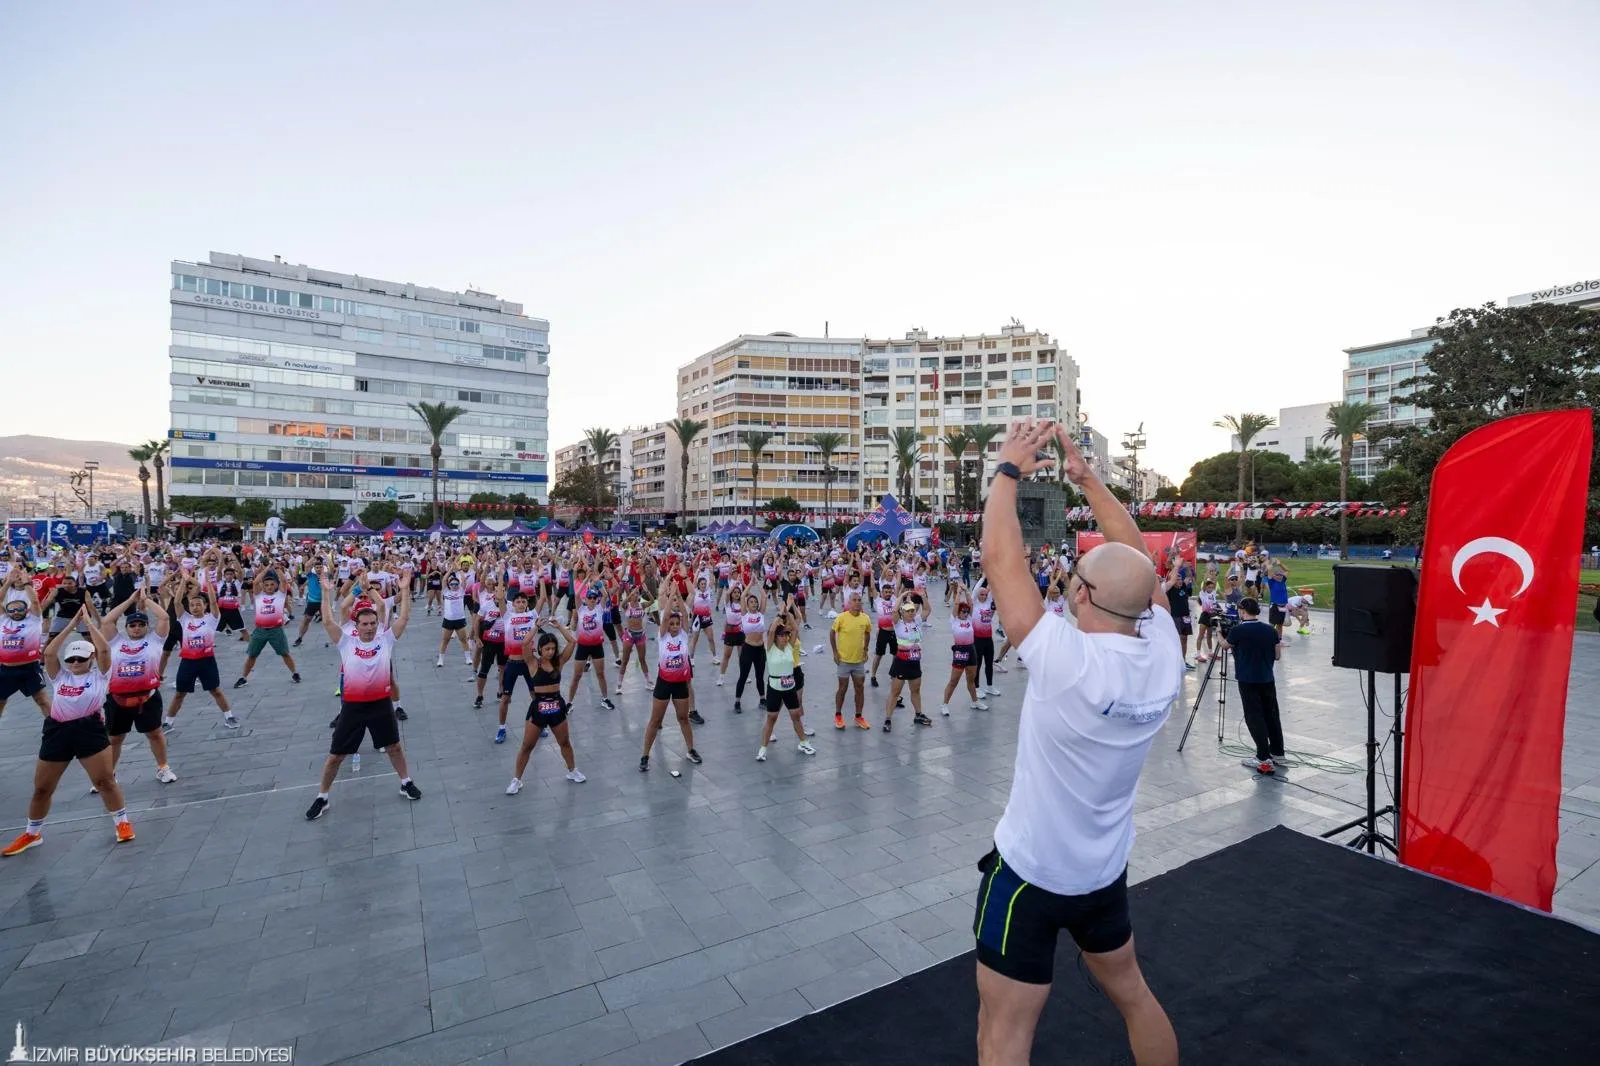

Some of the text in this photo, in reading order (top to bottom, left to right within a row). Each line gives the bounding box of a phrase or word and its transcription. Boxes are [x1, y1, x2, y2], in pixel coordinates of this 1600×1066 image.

[194, 295, 321, 320] OMEGA GLOBAL LOGISTICS
[867, 514, 886, 526] Bull
